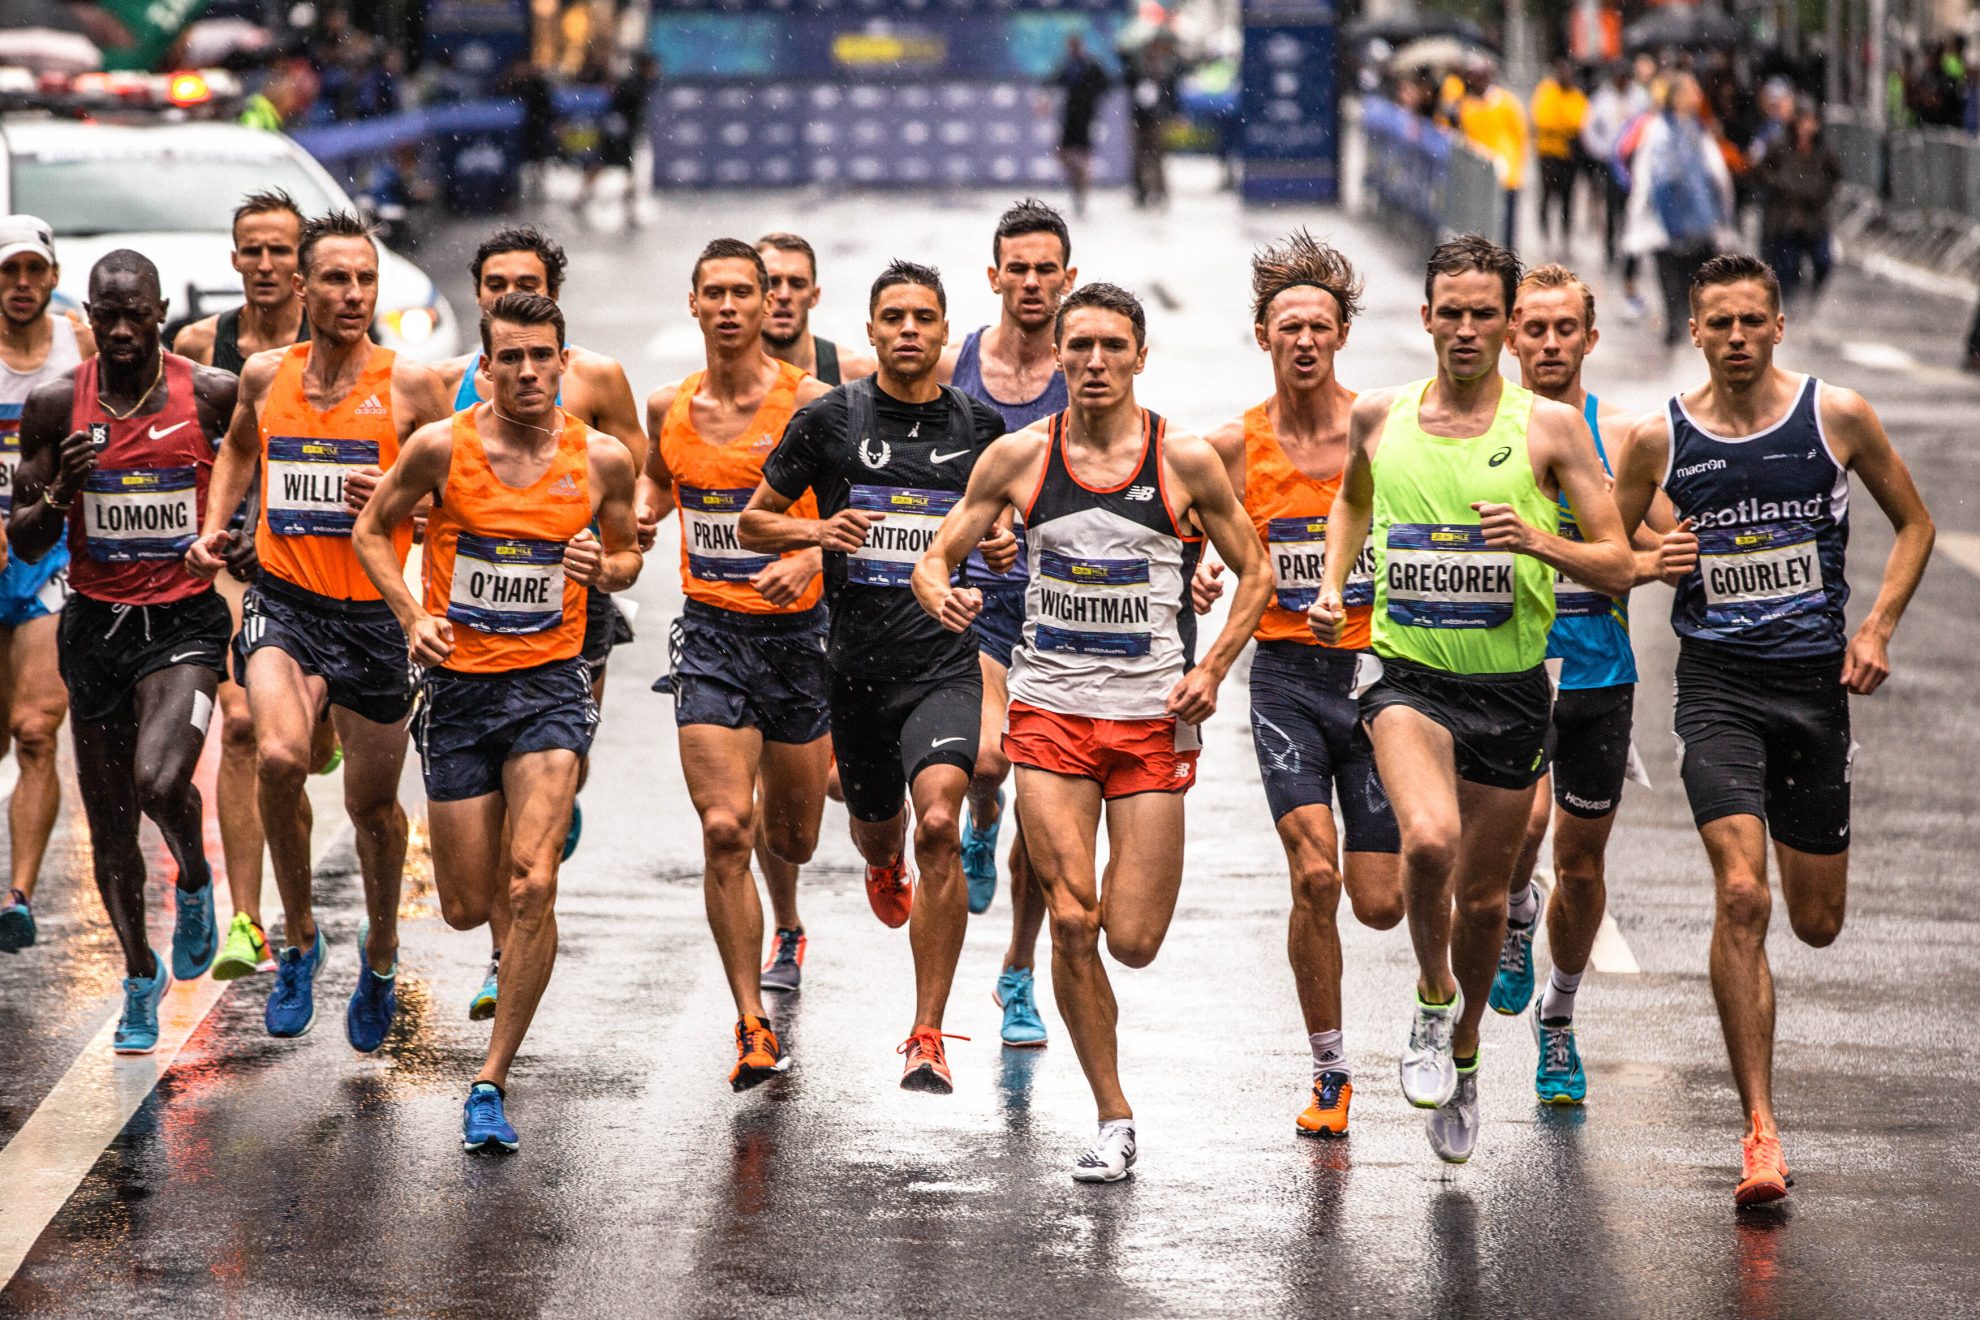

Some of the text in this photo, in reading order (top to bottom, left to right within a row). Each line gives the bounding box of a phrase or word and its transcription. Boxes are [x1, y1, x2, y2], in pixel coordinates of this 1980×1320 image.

[1676, 459, 1727, 479] macron
[284, 473, 343, 503] WILLI
[96, 501, 188, 532] LOMONG
[693, 521, 739, 550] PRAK
[1278, 546, 1378, 580] PARNS
[1388, 562, 1512, 594] GREGOREK
[1711, 555, 1812, 595] GOURLEY
[470, 571, 550, 603] O'HARE
[1040, 588, 1149, 624] WIGHTMAN
